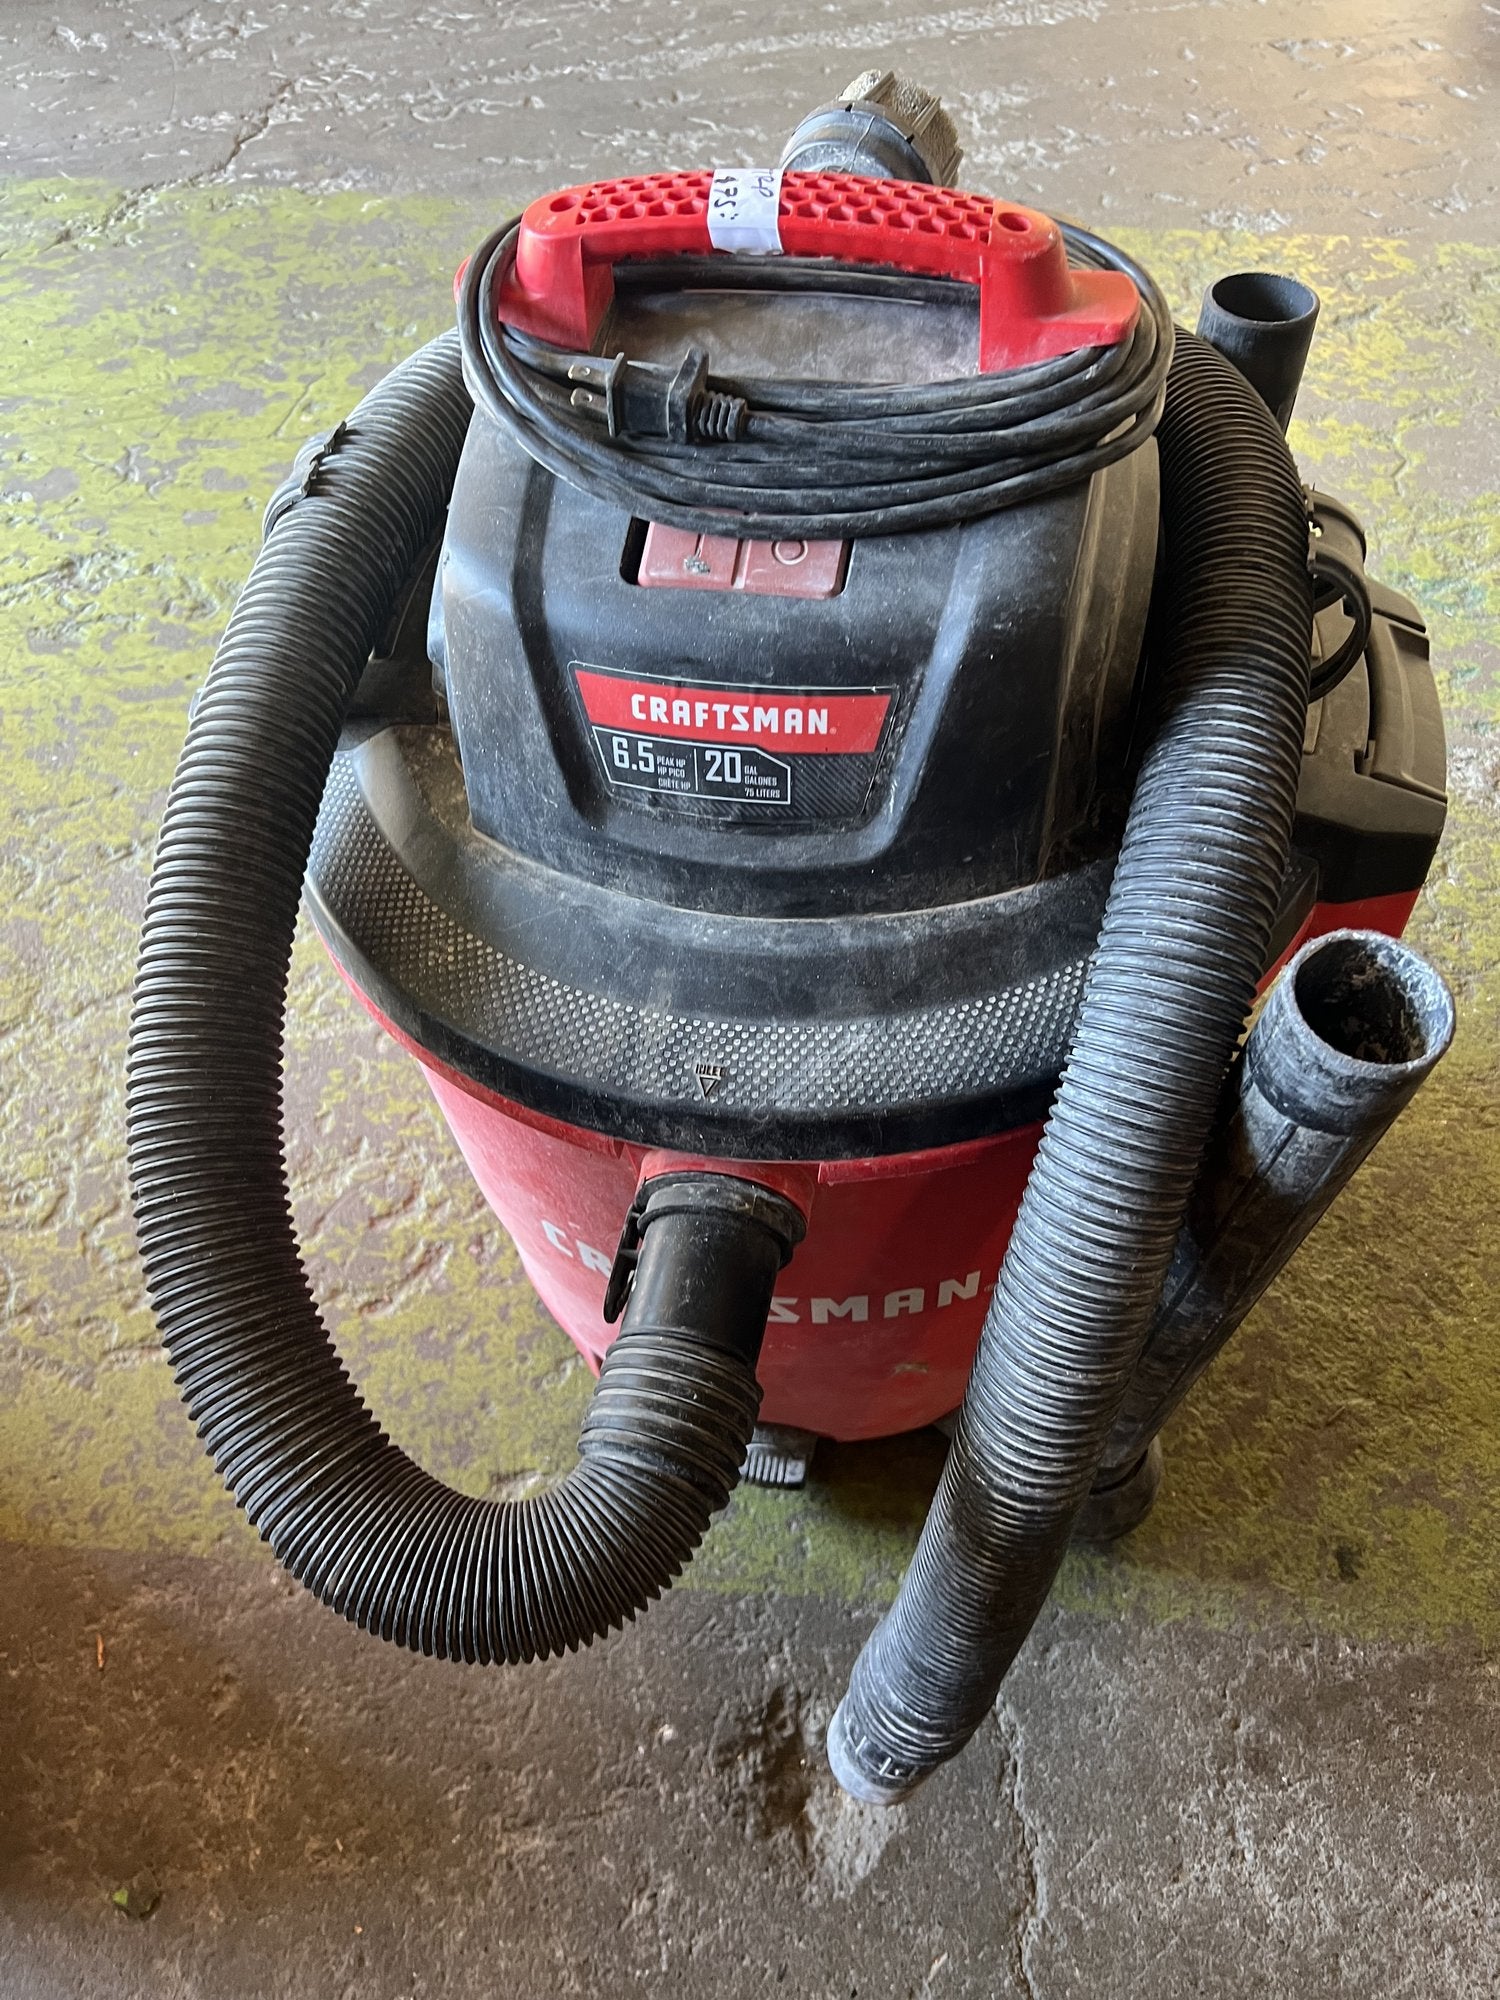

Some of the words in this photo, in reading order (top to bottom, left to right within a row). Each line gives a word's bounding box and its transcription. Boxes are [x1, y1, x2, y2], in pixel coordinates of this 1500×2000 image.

[631, 693, 829, 735] CRAFTSMAN
[612, 735, 655, 773] 6.5
[656, 755, 675, 767] PEAK
[675, 758, 686, 768] HP
[704, 749, 742, 784] 20
[657, 765, 667, 775] HP
[668, 767, 685, 778] PICO
[744, 765, 758, 776] GAL
[680, 781, 691, 791] HP
[756, 788, 780, 799] LITERS
[541, 1220, 981, 1325] CRSMAN
